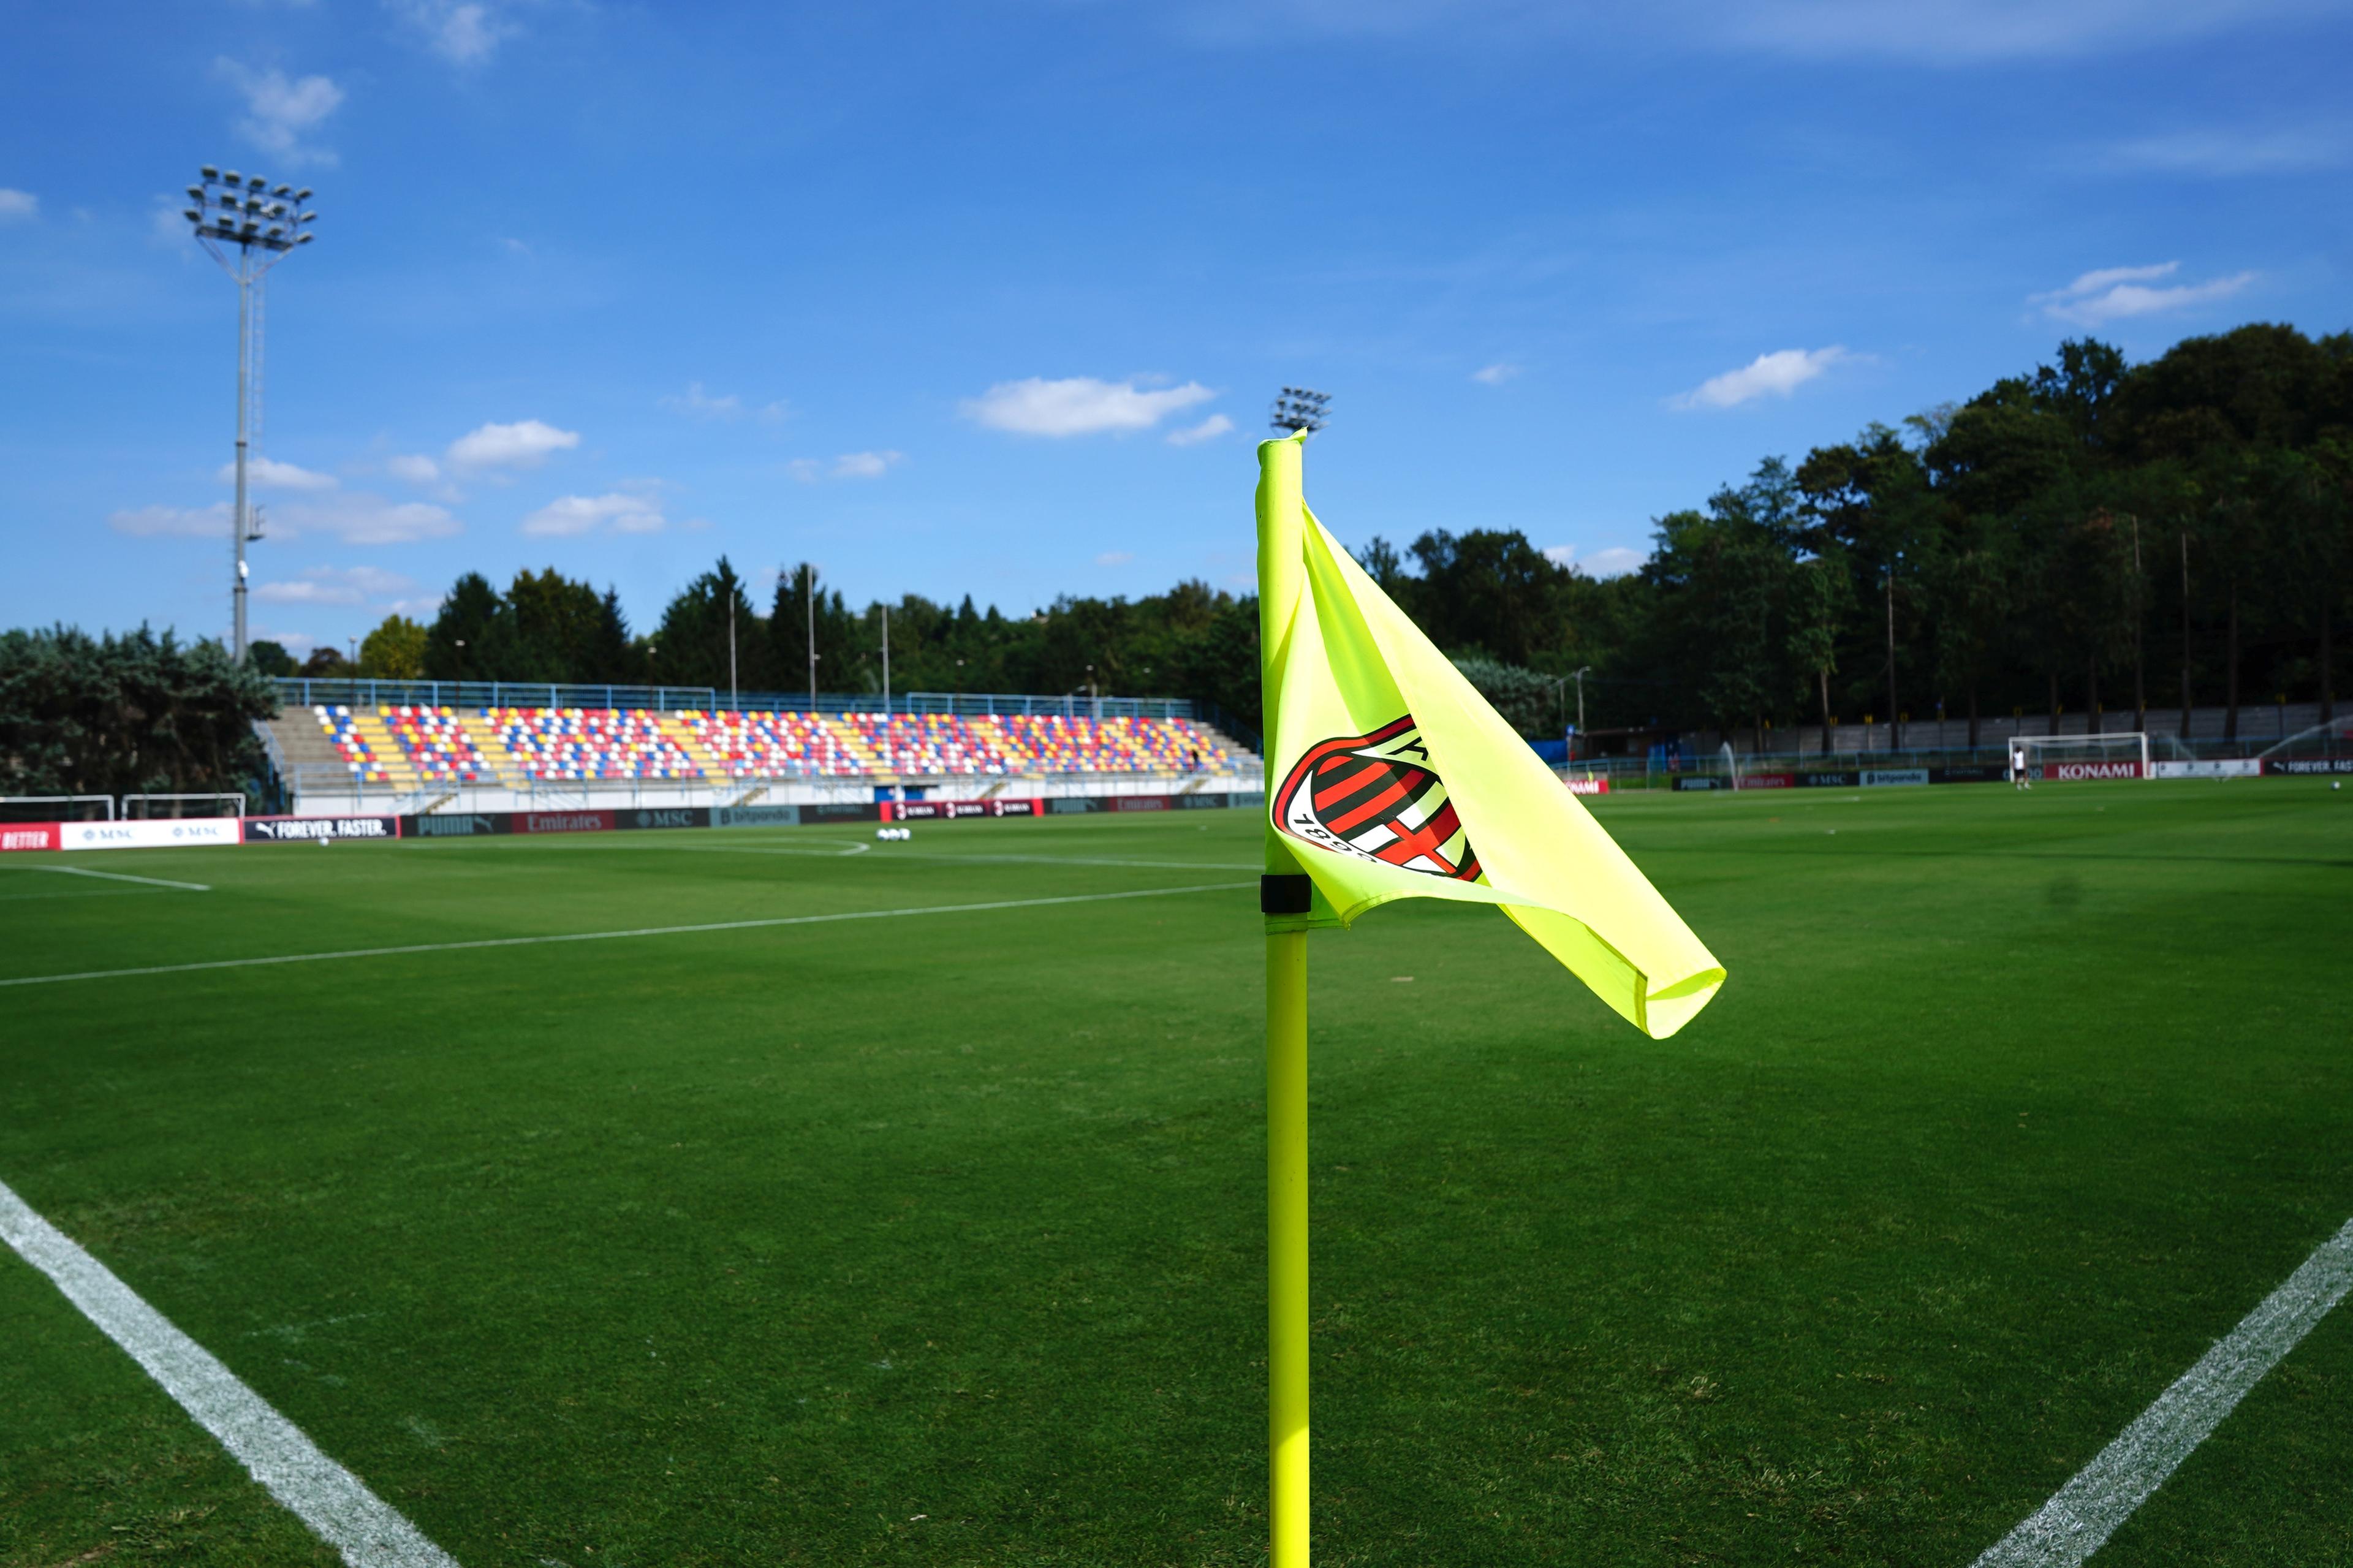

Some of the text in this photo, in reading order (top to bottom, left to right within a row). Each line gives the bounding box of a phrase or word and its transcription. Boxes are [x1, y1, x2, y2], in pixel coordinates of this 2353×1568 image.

[2058, 763, 2134, 780] KONAMI
[1565, 781, 1599, 794] ONAMI
[527, 814, 602, 832] Emirates
[654, 810, 693, 826] MSC
[277, 819, 387, 838] FOREVER. FASTER.
